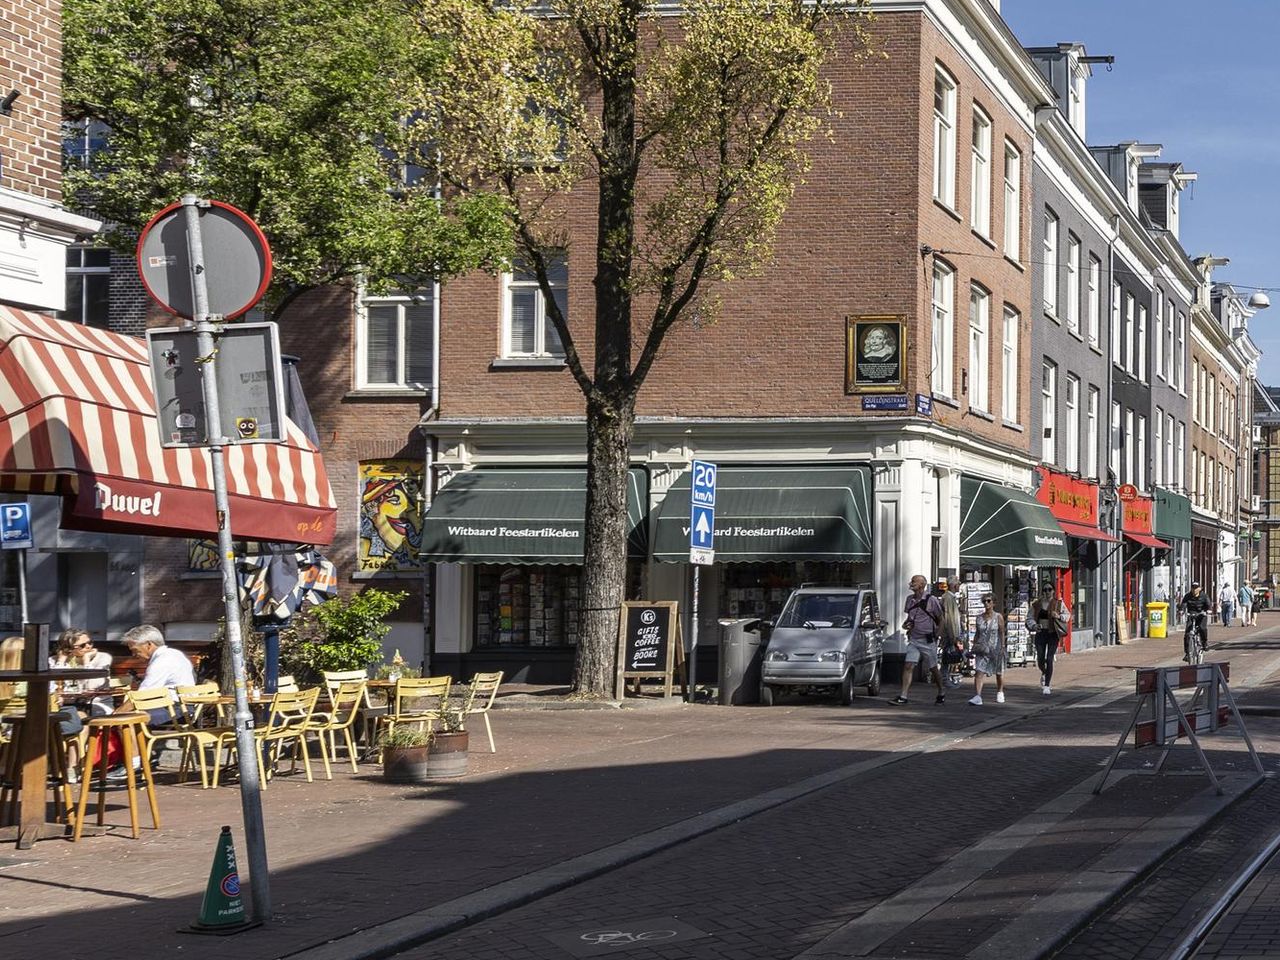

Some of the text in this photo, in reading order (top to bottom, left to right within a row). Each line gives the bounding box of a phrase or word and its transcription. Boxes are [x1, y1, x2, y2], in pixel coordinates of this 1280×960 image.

[695, 465, 715, 488] 20
[94, 481, 162, 517] Duvel
[694, 489, 713, 503] km/h
[6, 506, 24, 527] P
[448, 526, 580, 538] Witbaard Feestartikelen
[733, 526, 816, 538] Feestartikelen
[637, 626, 659, 635] GIFTS
[634, 637, 661, 647] COFFEE
[633, 650, 658, 660] BOOKS
